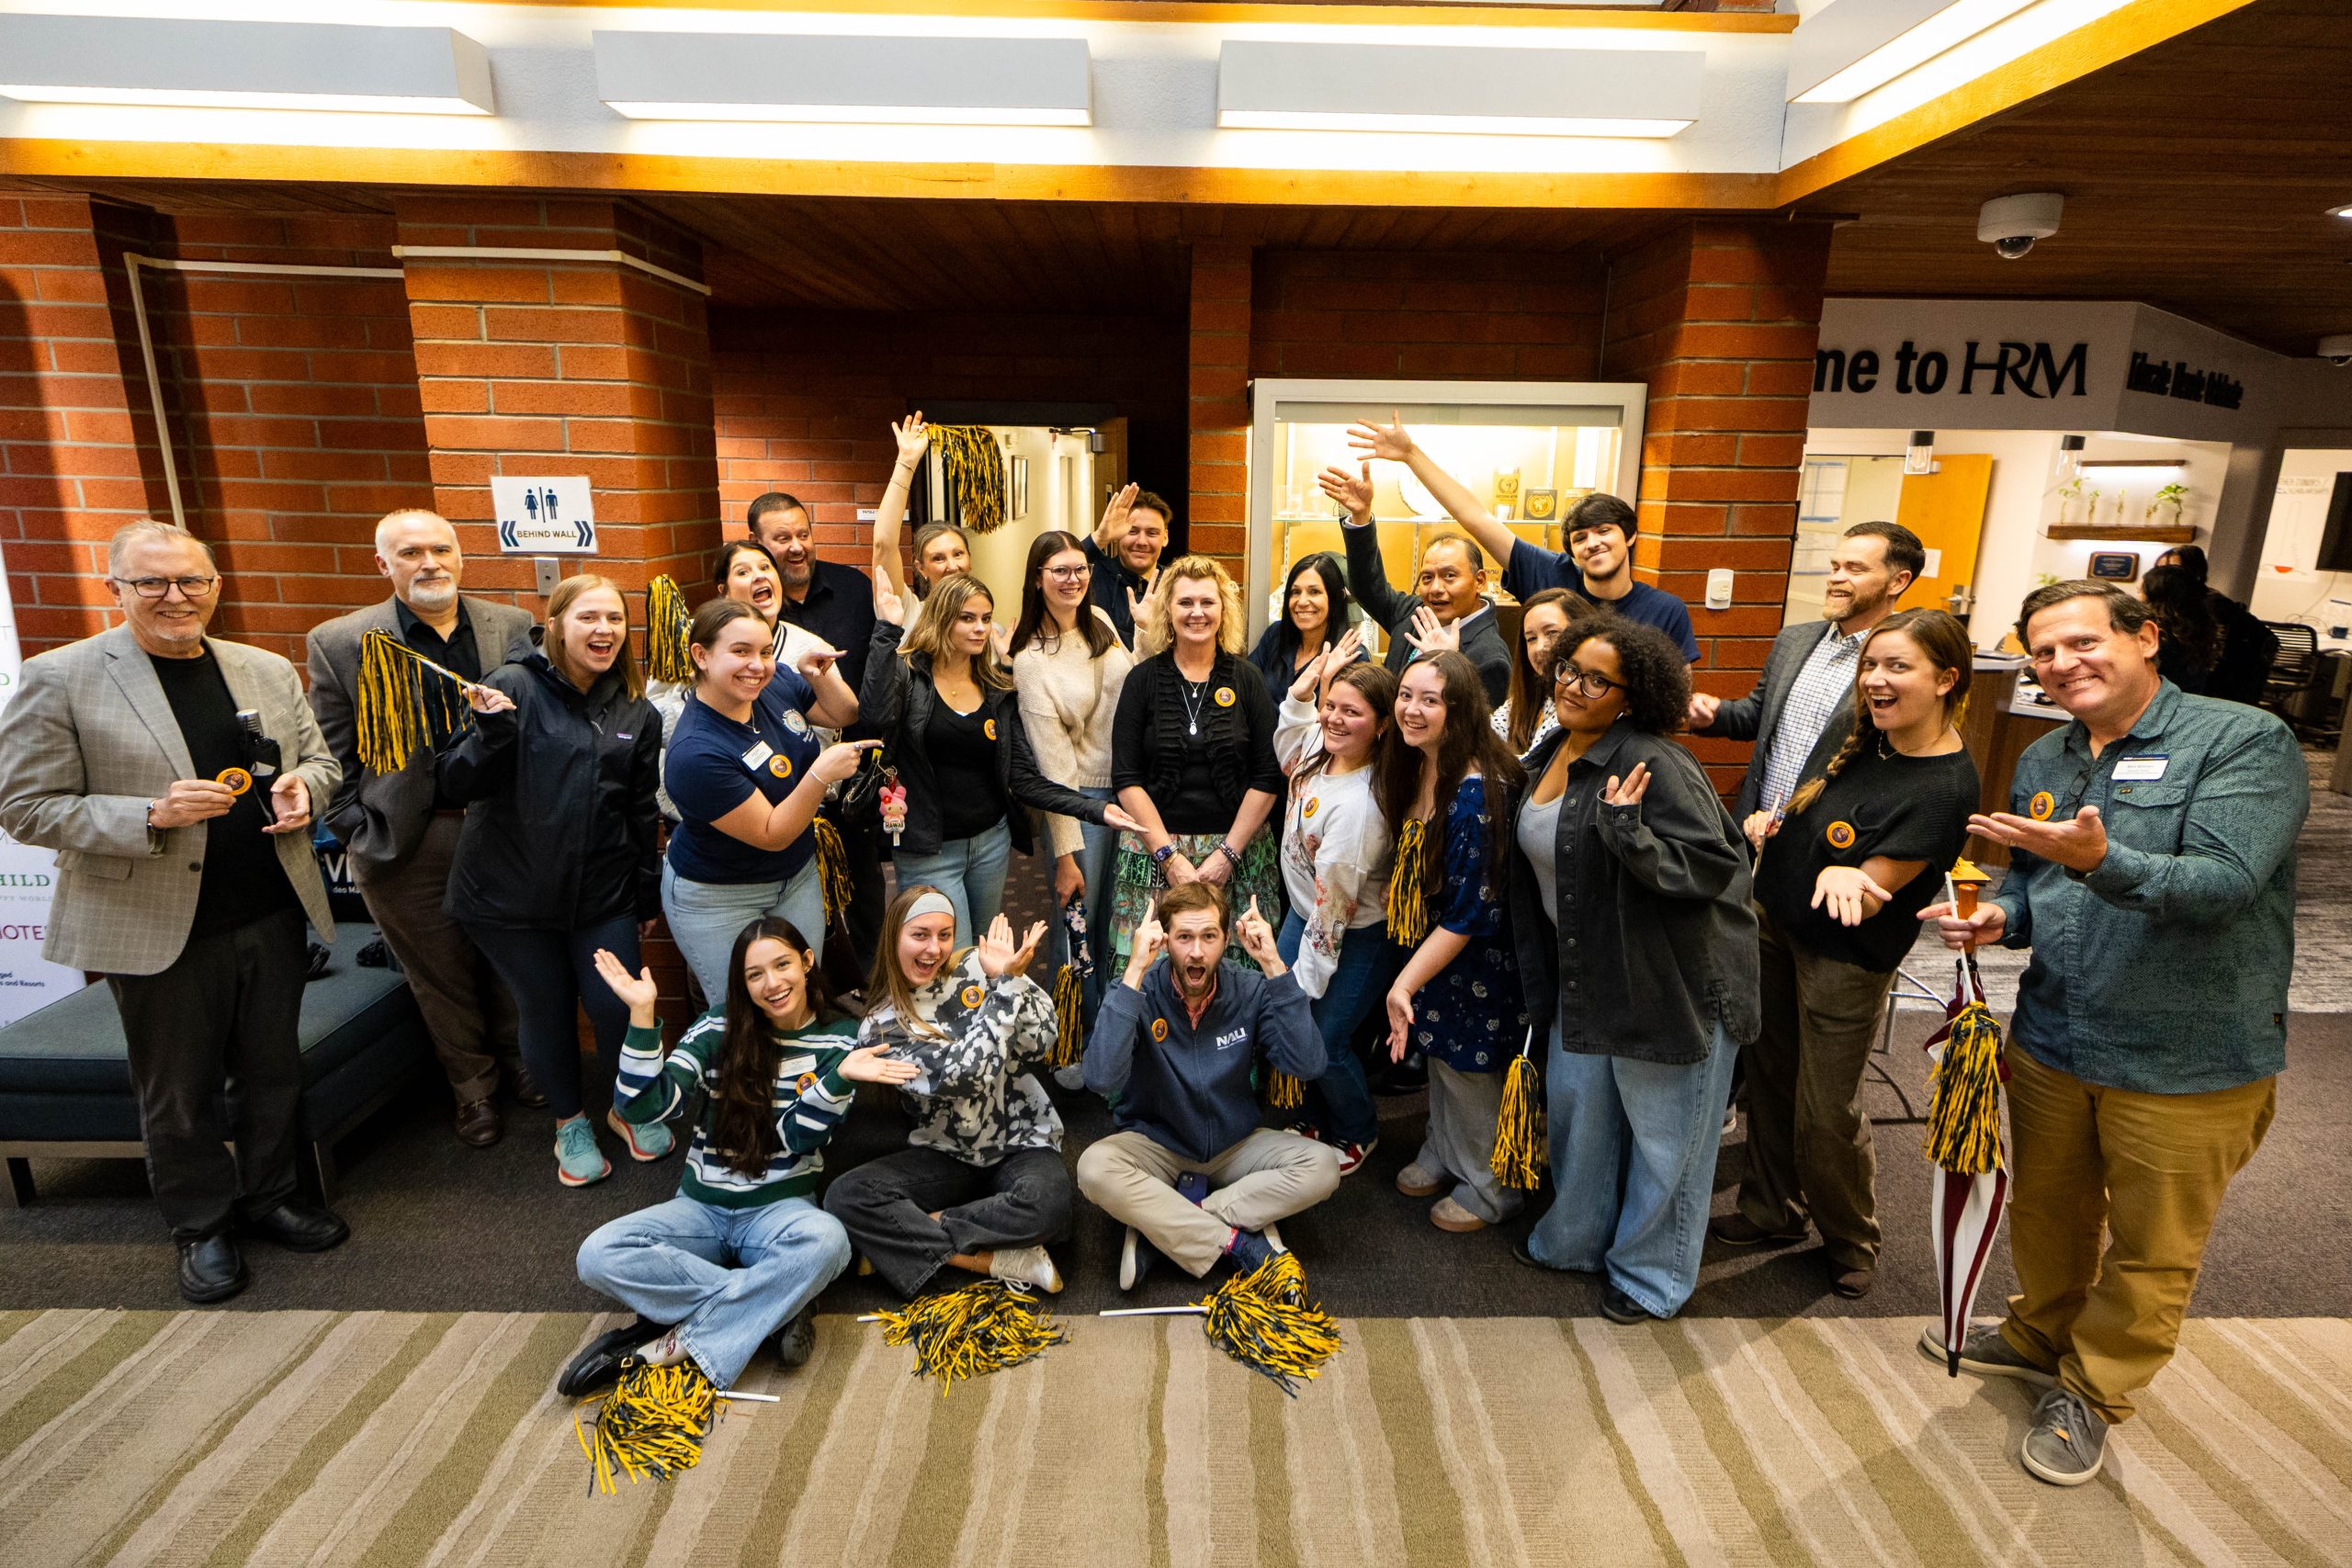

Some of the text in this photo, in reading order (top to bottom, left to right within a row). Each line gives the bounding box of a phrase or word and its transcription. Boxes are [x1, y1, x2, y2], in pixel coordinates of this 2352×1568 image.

[1895, 341, 1949, 395] to
[1958, 341, 2088, 399] HRM
[516, 530, 577, 538] BEHIND WALL
[1216, 1027, 1246, 1047] NAU
